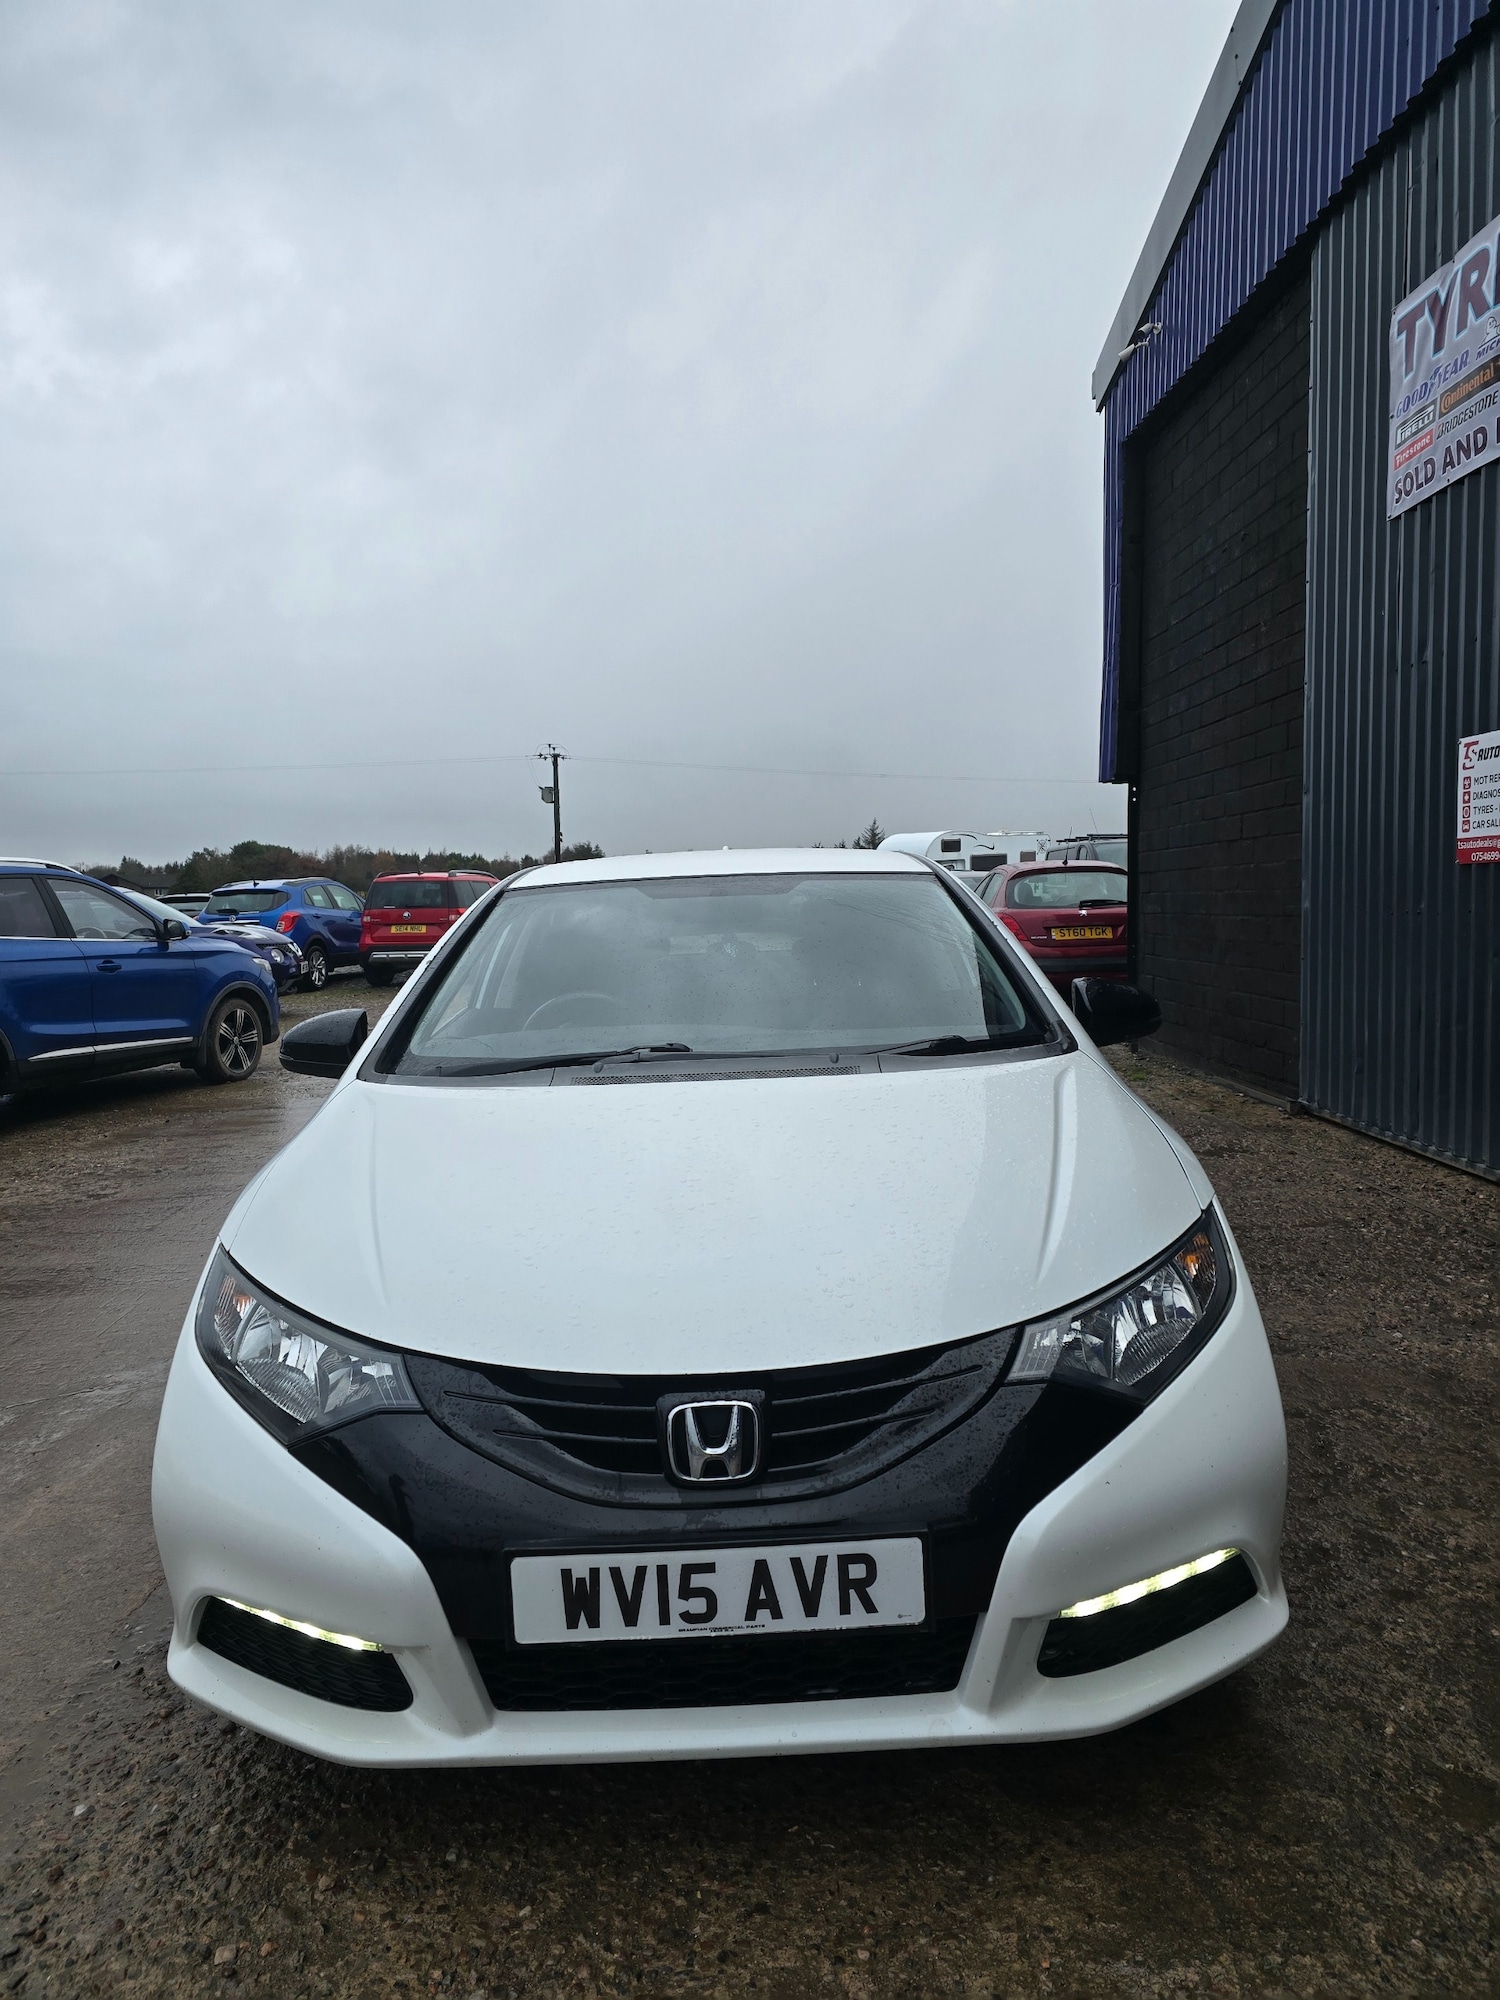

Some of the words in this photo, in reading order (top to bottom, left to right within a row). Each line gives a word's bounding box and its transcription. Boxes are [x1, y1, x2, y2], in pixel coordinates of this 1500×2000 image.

[1397, 231, 1500, 379] TYR
[1396, 350, 1469, 418] GOODYEAR
[1441, 362, 1494, 414] Continental
[1396, 404, 1434, 445] PIRELLI
[1436, 390, 1499, 440] BRIDGESTONE
[1394, 457, 1436, 505] SOLD
[1441, 426, 1488, 476] AND
[1395, 435, 1431, 467] Firestone
[1473, 776, 1488, 786] MOT
[1472, 820, 1485, 830] CAR
[1473, 804, 1493, 815] TYRES
[1060, 928, 1086, 937] ST60
[1087, 927, 1108, 936] TGK
[560, 1562, 718, 1630] WV15
[744, 1553, 879, 1622] AVR
